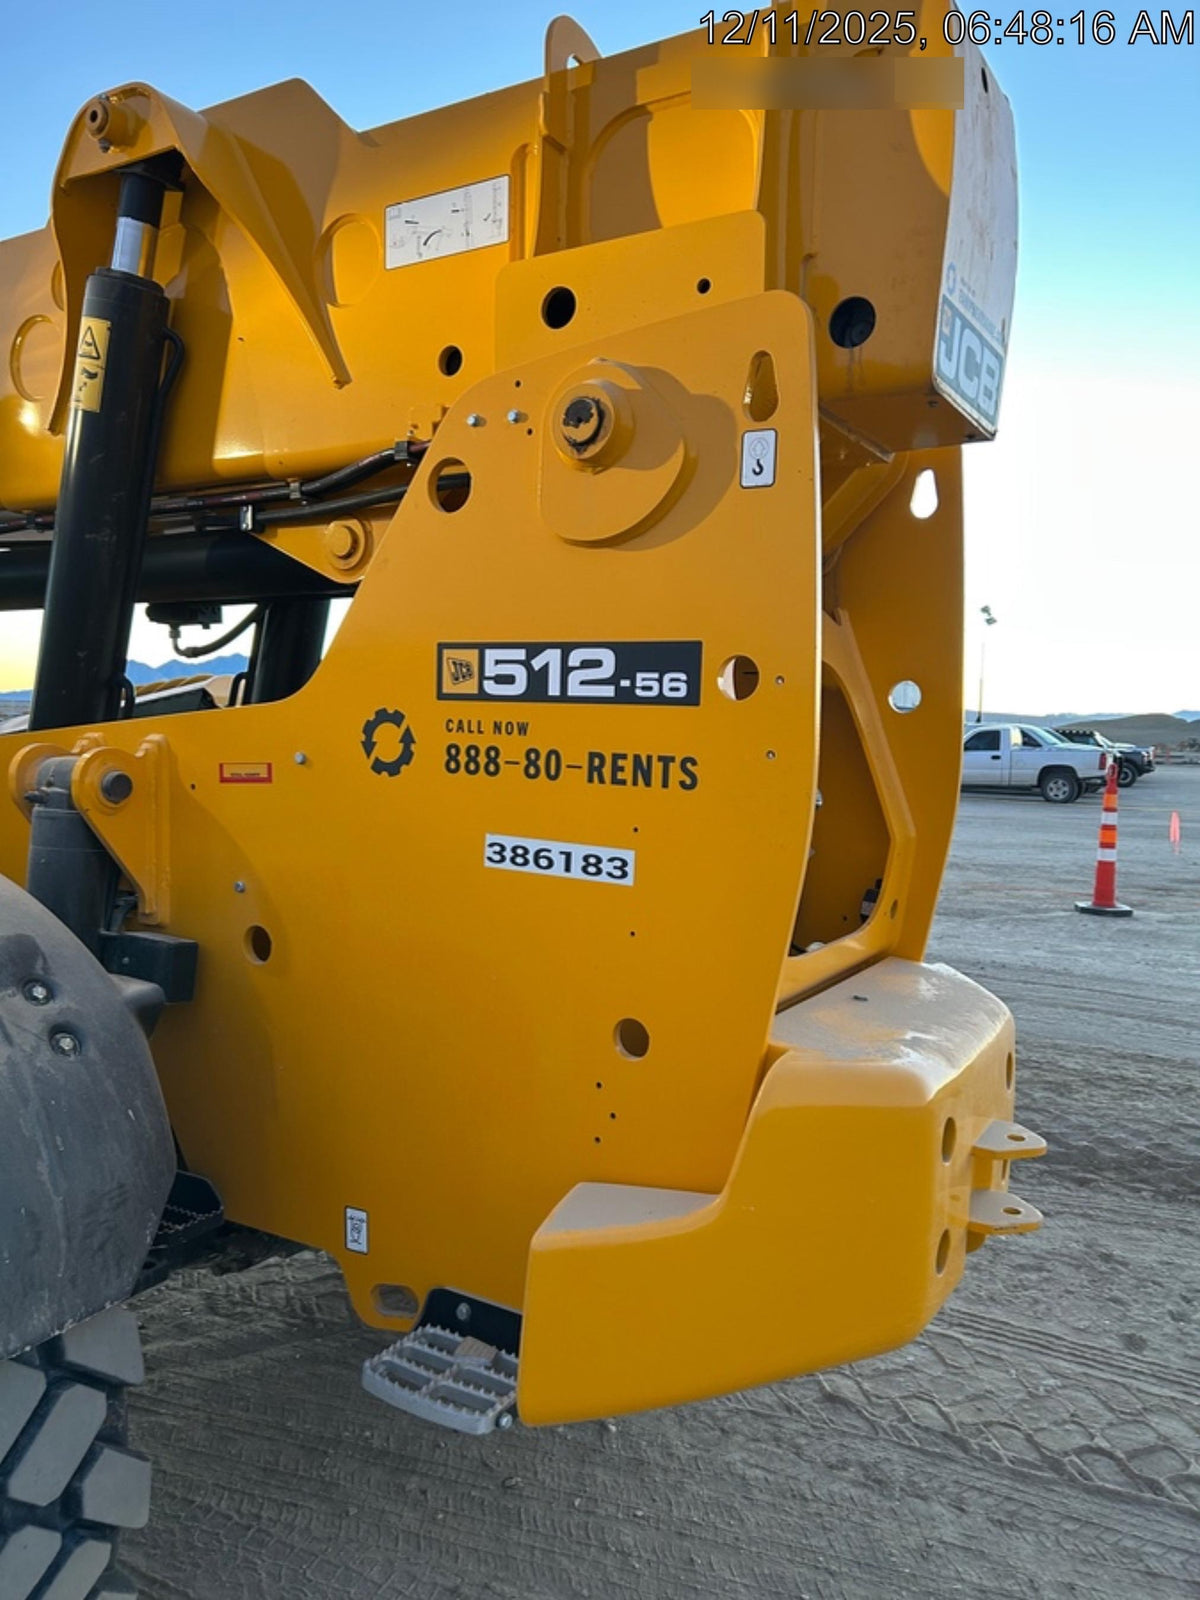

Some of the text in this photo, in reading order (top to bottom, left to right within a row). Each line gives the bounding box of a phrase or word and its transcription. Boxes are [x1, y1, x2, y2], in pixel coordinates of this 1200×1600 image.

[939, 316, 1001, 416] JCB
[482, 647, 689, 698] 512-56
[445, 718, 530, 737] CALL NOW
[445, 743, 700, 791] 888-80-RENTS
[486, 842, 630, 880] 386183
